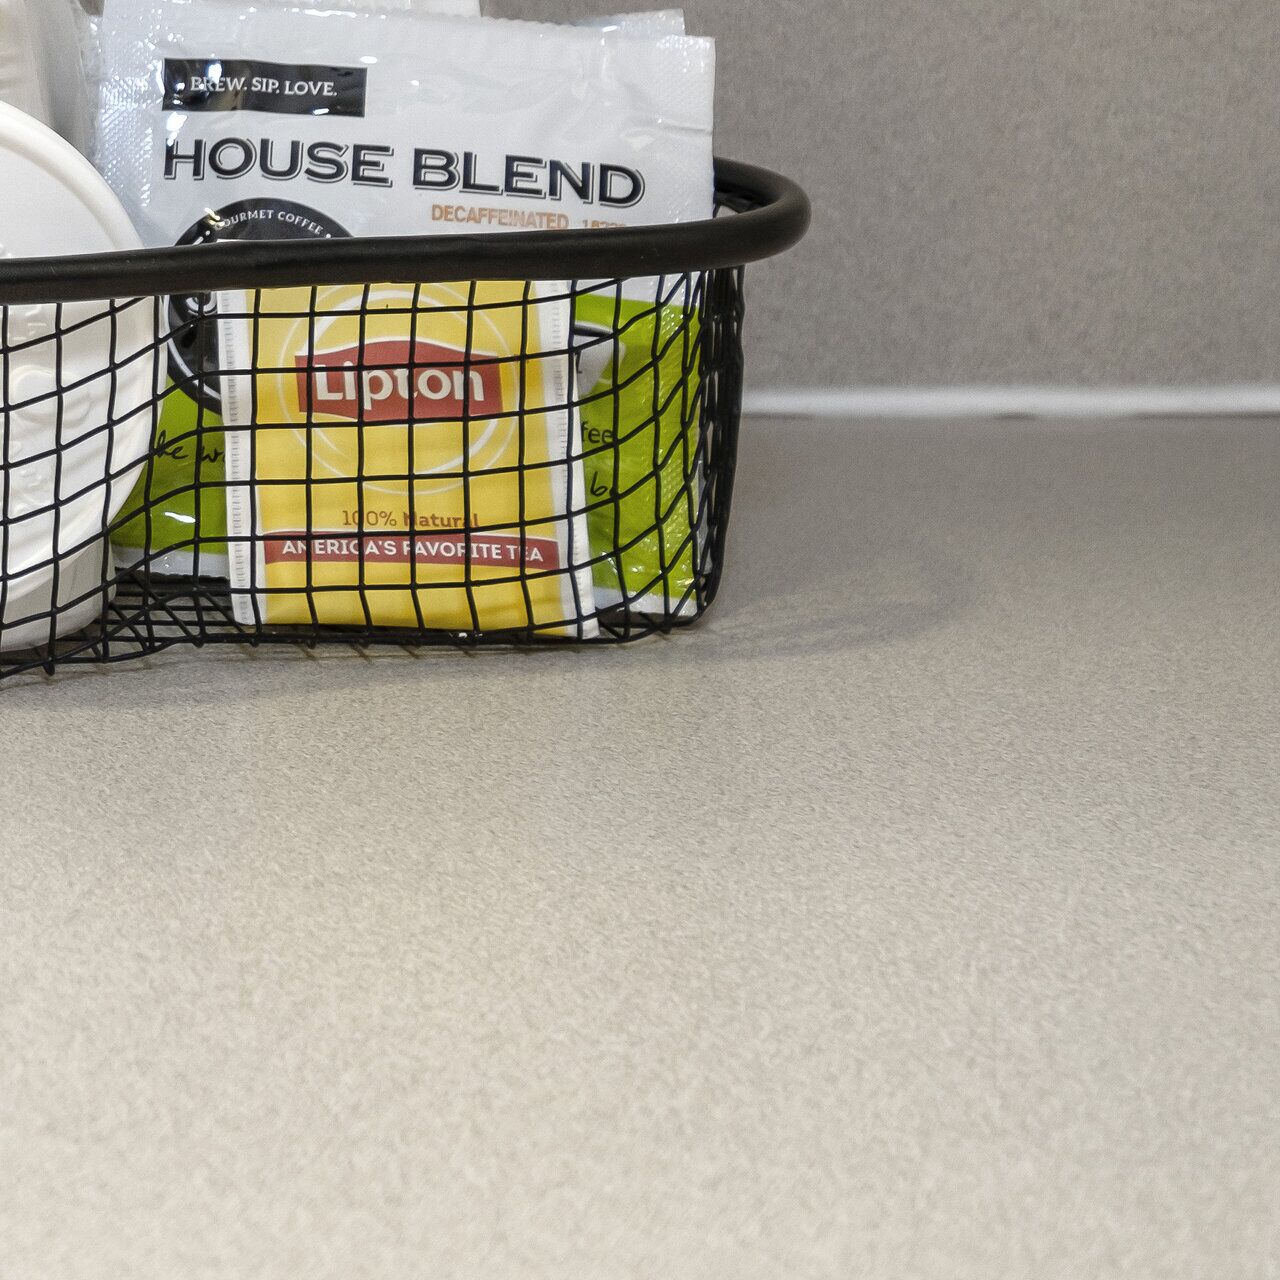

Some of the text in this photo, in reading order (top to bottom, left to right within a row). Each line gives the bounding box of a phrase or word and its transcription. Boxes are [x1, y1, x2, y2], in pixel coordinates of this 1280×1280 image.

[190, 77, 338, 97] BREW. SIP. LOVE.
[163, 137, 646, 208] HOUSE BLEND
[277, 211, 324, 235] COFFEE
[431, 204, 569, 230] DECAFFEINATED
[314, 360, 486, 410] Lipton
[342, 510, 480, 527] 100% Naturl
